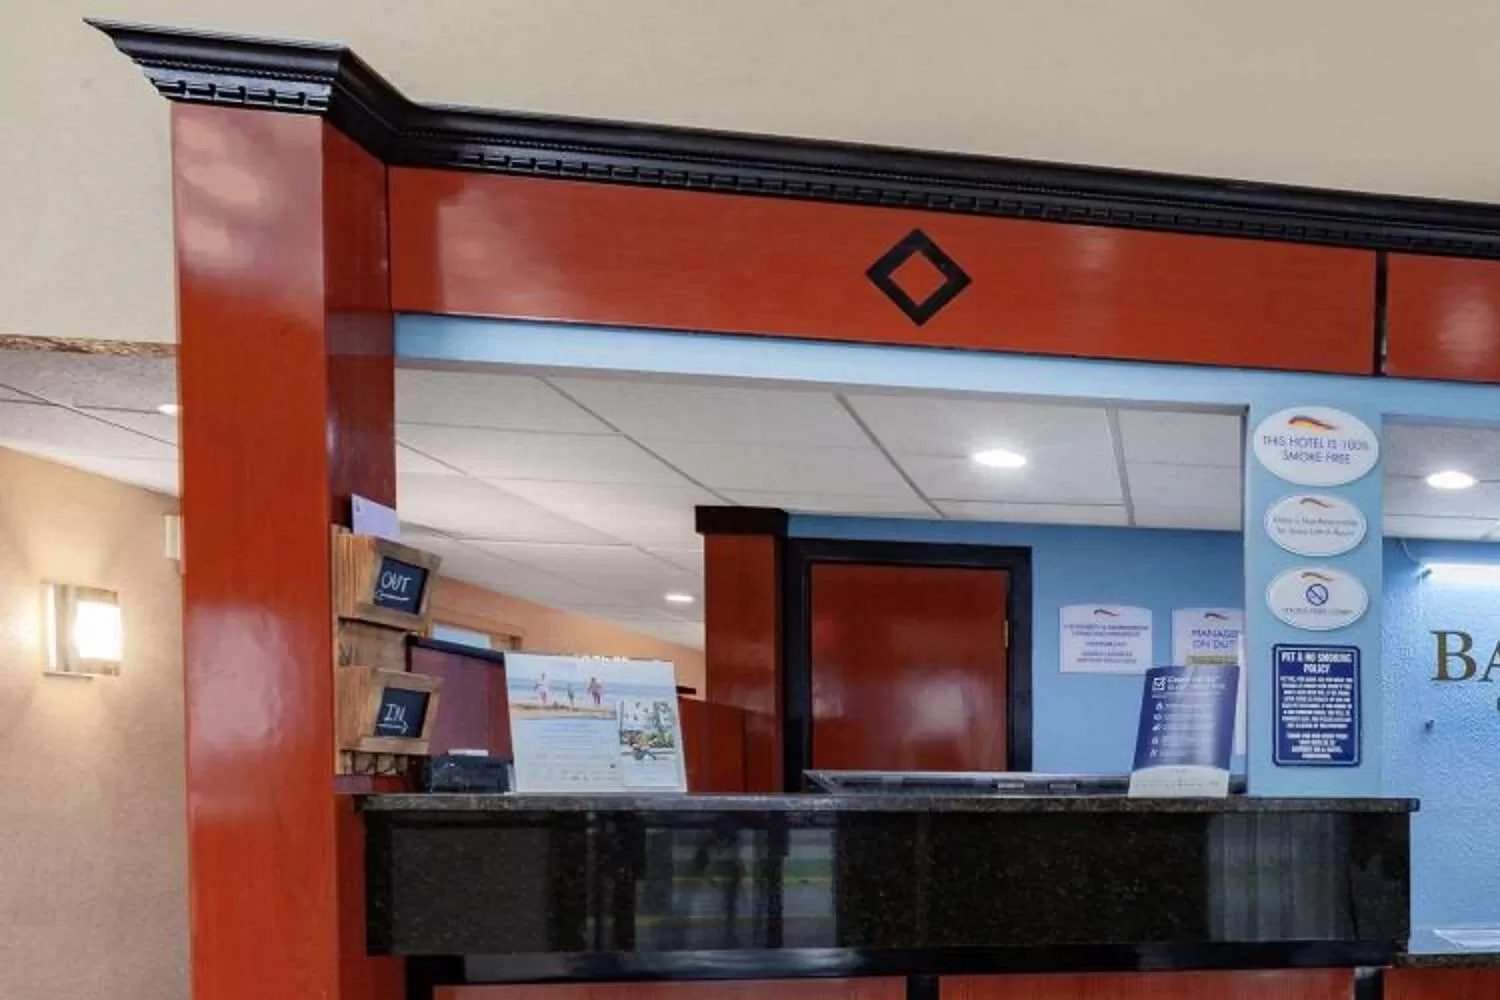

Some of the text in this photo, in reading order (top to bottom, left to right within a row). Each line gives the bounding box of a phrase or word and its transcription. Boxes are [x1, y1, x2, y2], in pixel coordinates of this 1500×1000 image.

[1263, 435, 1286, 446] THIS
[1289, 436, 1324, 449] HOTEL
[1327, 438, 1338, 450] IS
[1281, 450, 1351, 465] SMOKE FREE
[381, 570, 413, 594] OUT
[1191, 628, 1240, 639] MANAGE
[1212, 639, 1238, 651] DUT
[382, 702, 407, 722] IN
